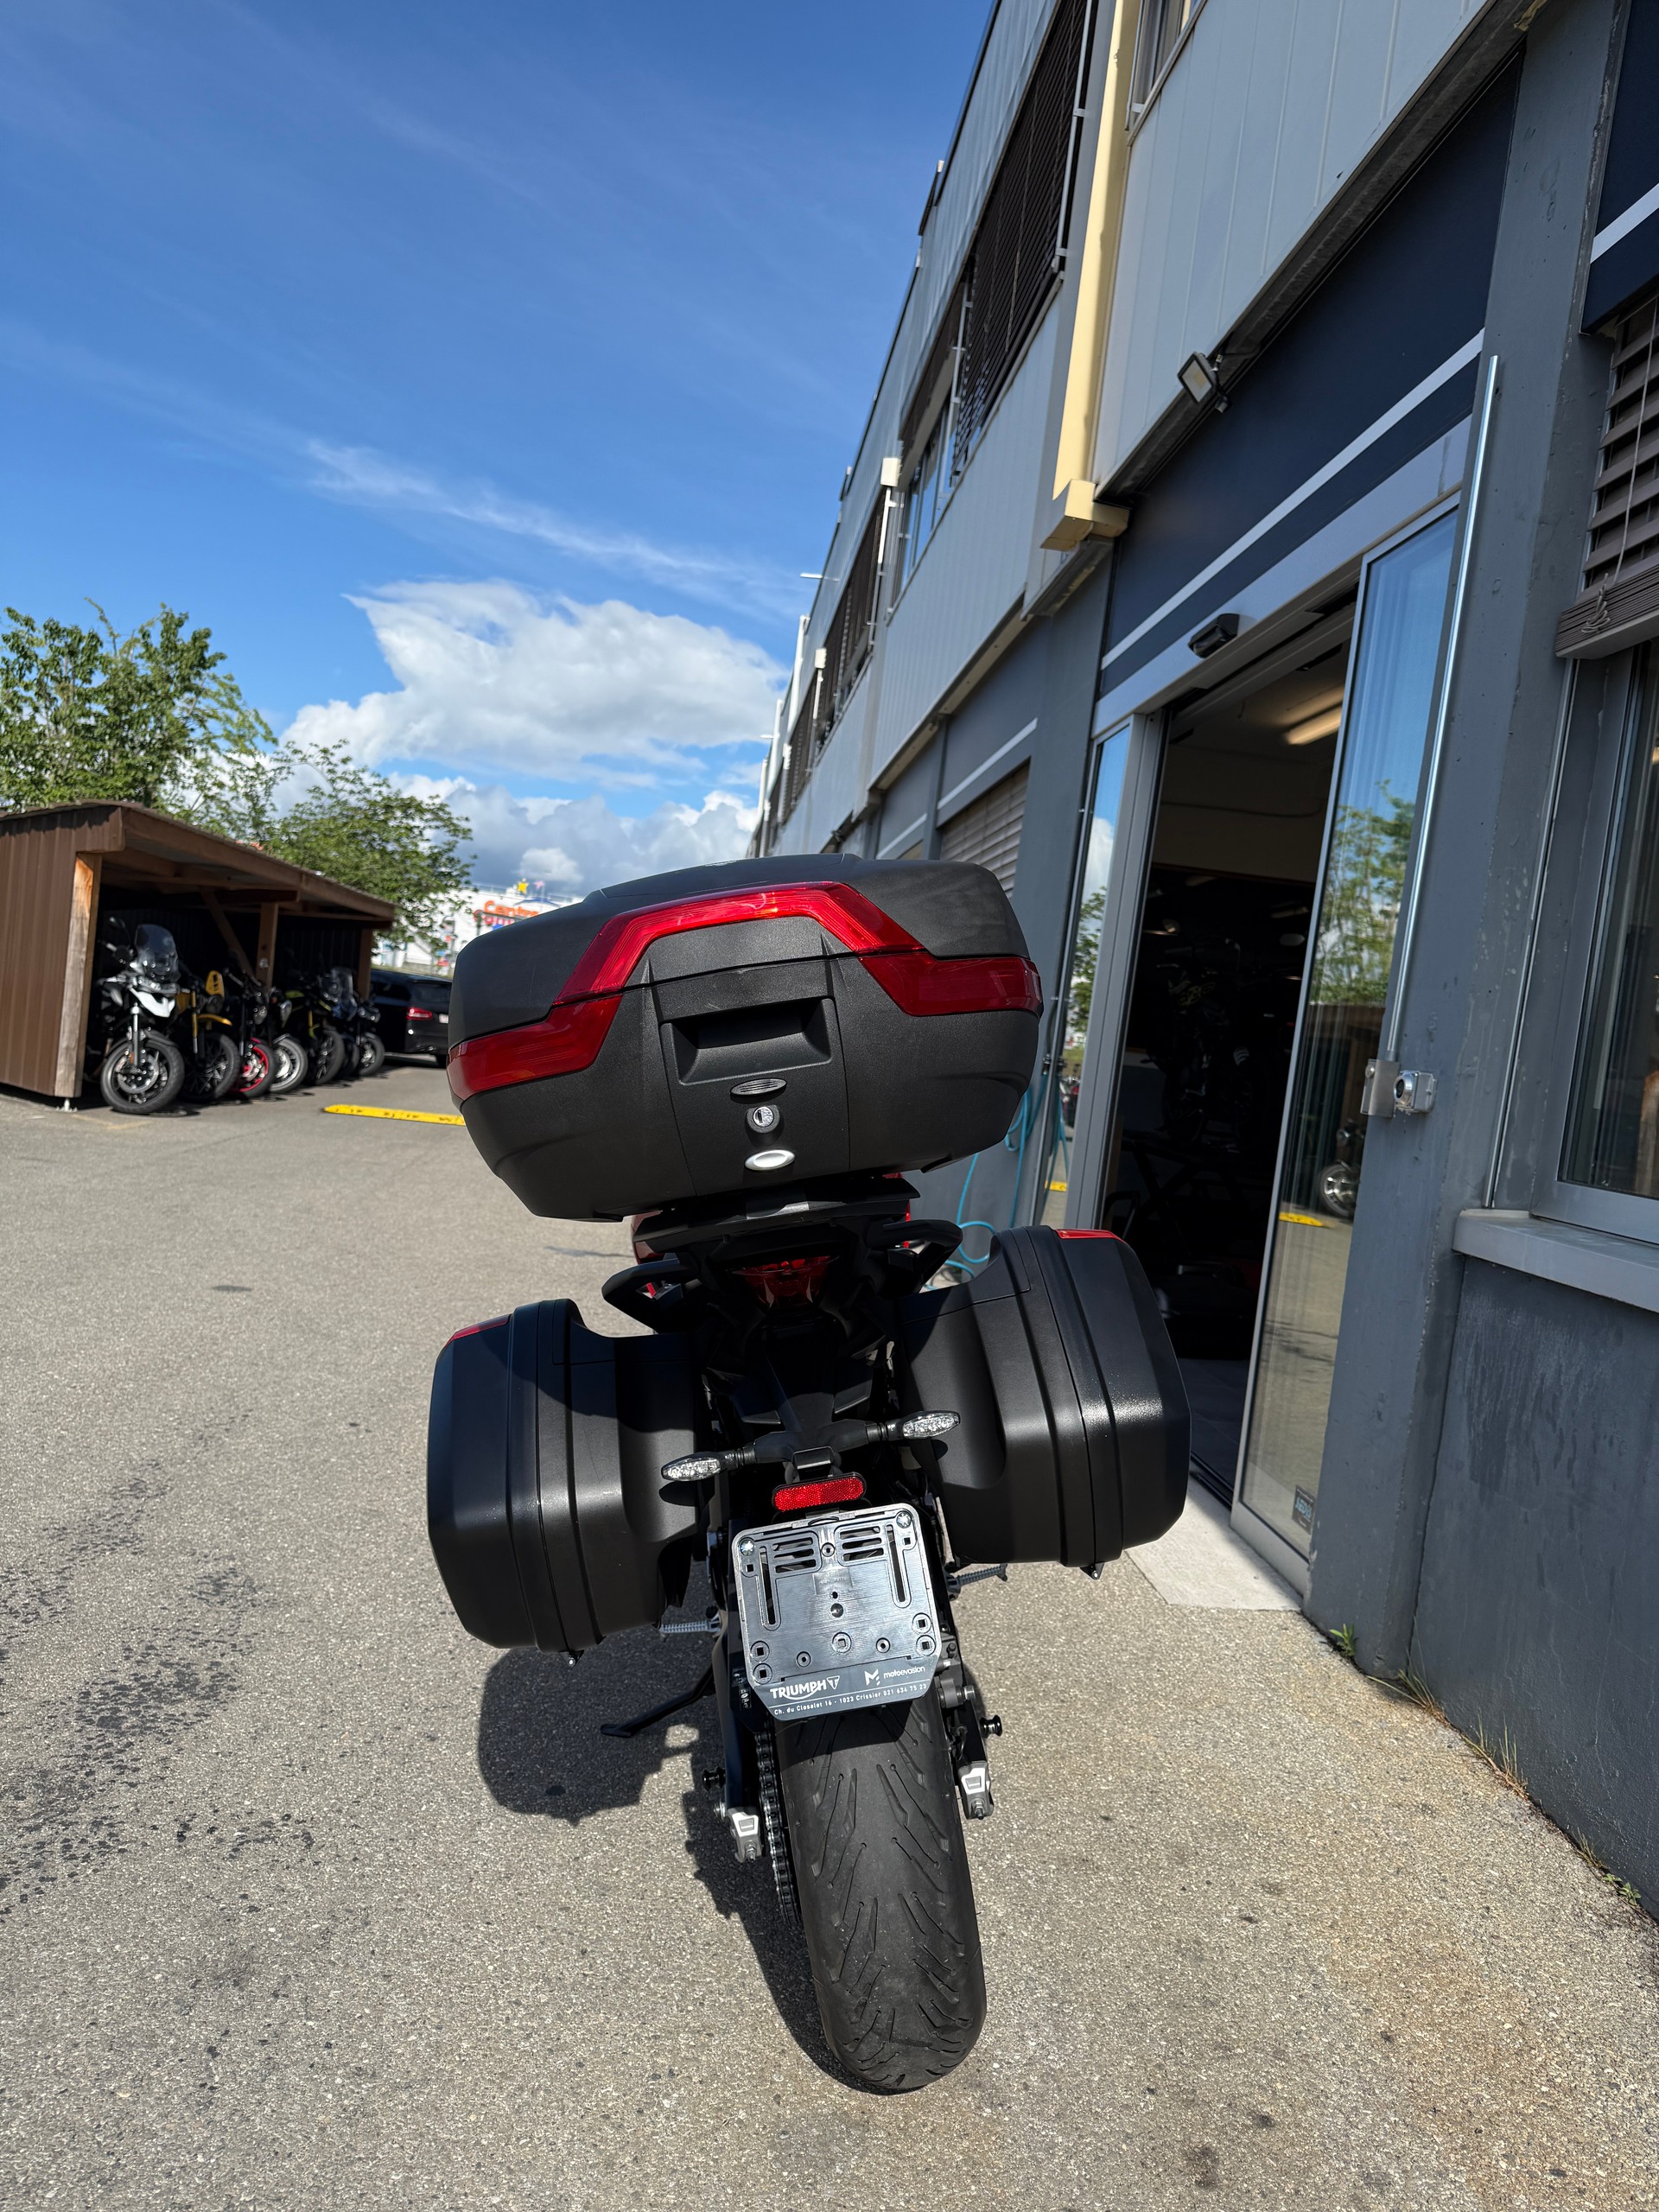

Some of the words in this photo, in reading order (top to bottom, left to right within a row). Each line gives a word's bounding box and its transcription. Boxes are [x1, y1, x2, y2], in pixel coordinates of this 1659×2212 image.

[883, 1666, 925, 1679] motoevasion
[770, 1680, 827, 1700] TRIUMPH
[856, 1692, 881, 1700] Crissier
